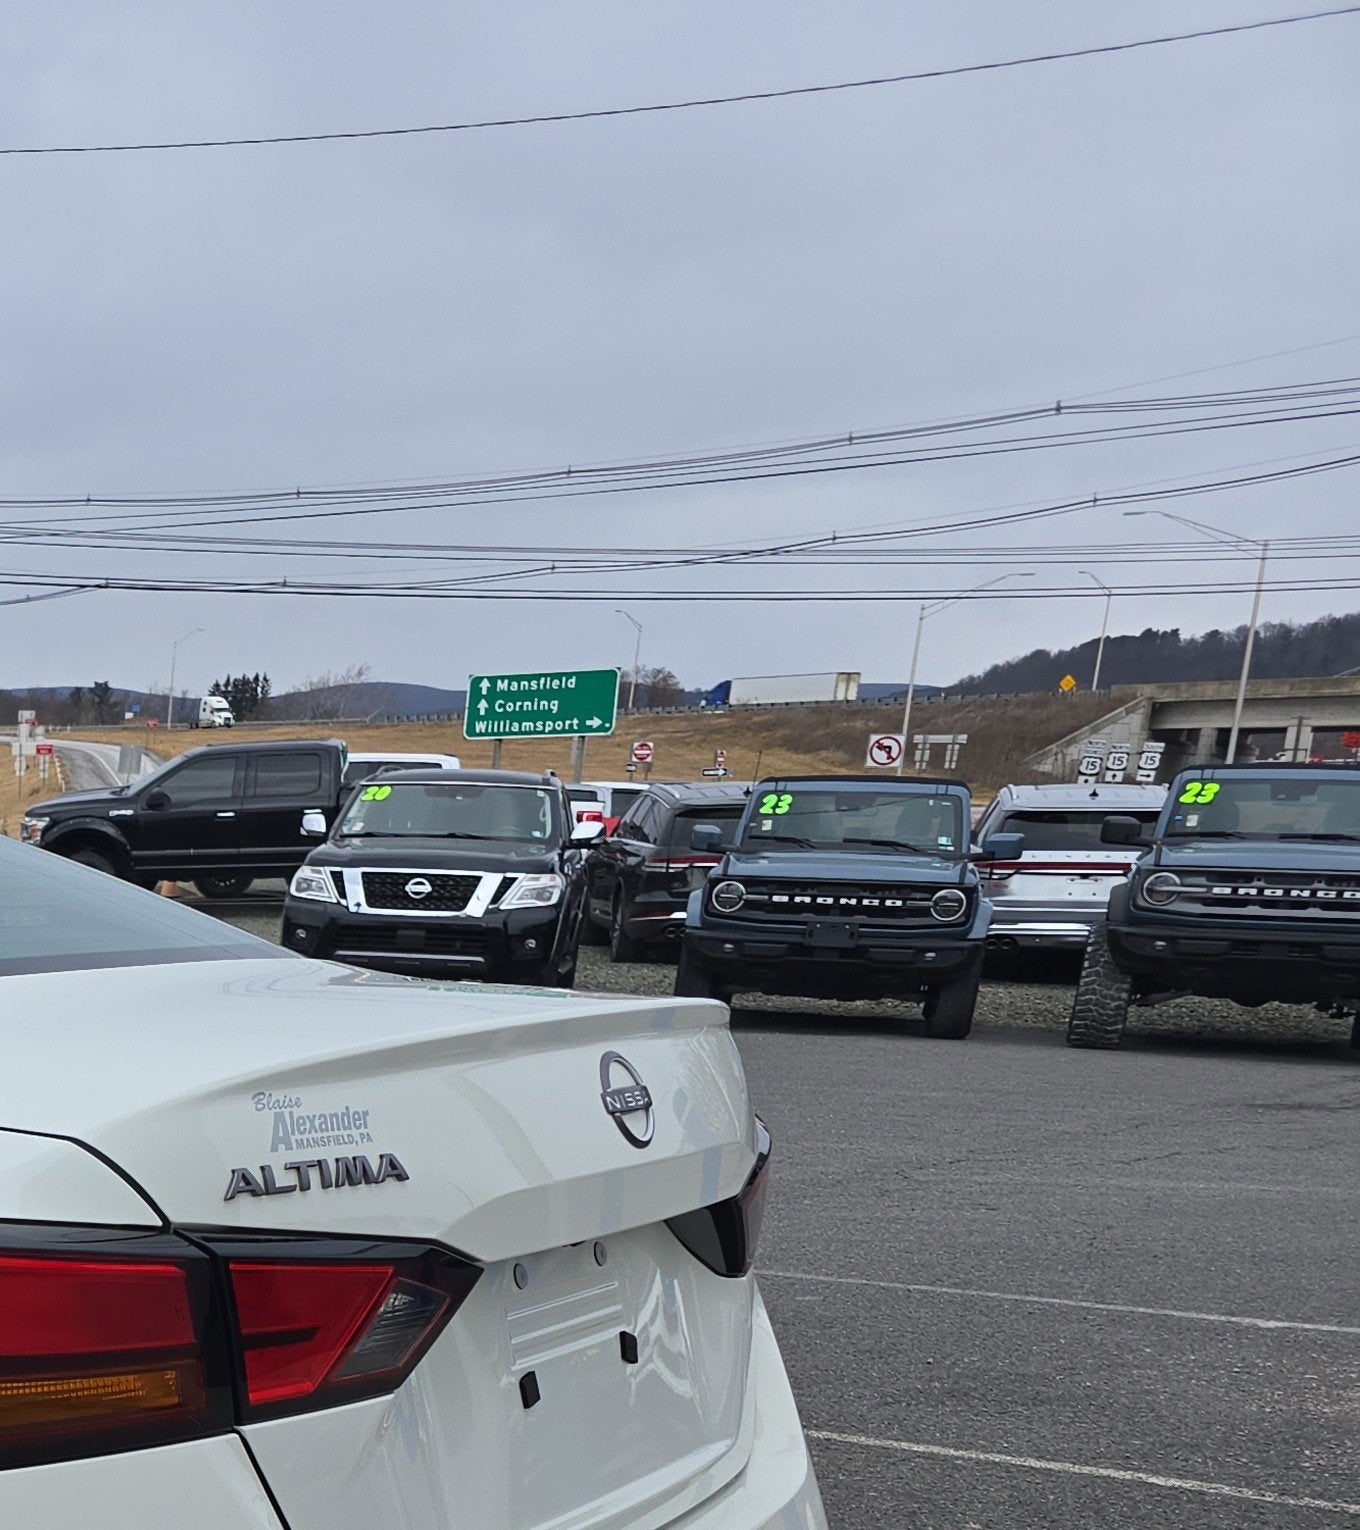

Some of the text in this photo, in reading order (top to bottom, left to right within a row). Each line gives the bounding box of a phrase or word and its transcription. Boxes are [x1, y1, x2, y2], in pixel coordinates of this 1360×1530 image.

[496, 676, 576, 692] Mansfield
[494, 698, 559, 713] Corning
[475, 717, 579, 733] Williamsport
[1085, 760, 1098, 771] 15
[1112, 756, 1124, 766] 15
[1144, 755, 1157, 766] 15
[361, 786, 392, 801] 20
[1179, 782, 1220, 804] 23
[758, 794, 793, 814] 23
[772, 895, 903, 906] BRONCO
[1212, 887, 1360, 898] BRONCO
[251, 1091, 302, 1112] Blaise
[606, 1091, 649, 1110] NISS
[270, 1106, 369, 1153] Alexander
[295, 1132, 373, 1150] MANSFIELD, PA
[223, 1153, 410, 1201] ALTIMA
